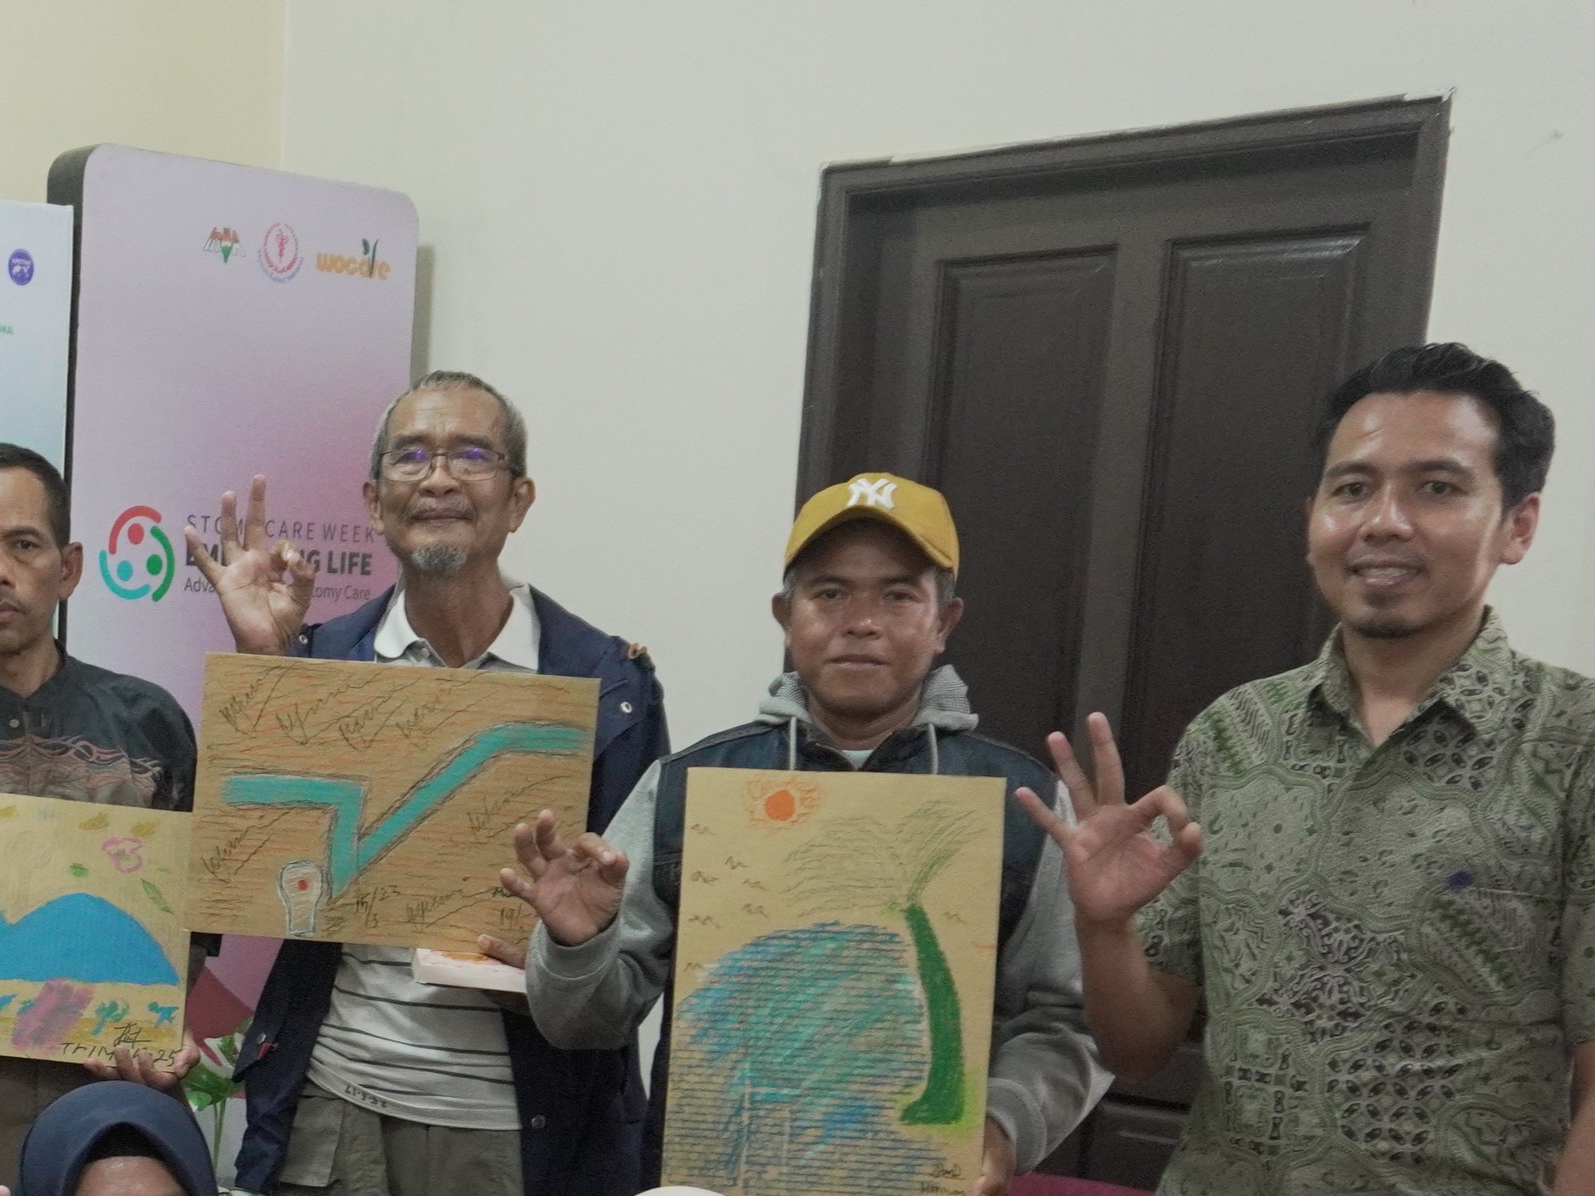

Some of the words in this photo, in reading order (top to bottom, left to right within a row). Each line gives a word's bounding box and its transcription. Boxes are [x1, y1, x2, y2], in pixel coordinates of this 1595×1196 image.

[264, 520, 316, 541] CARE
[322, 523, 375, 543] WEEK
[327, 551, 373, 576] LIFE
[344, 585, 371, 600] Care
